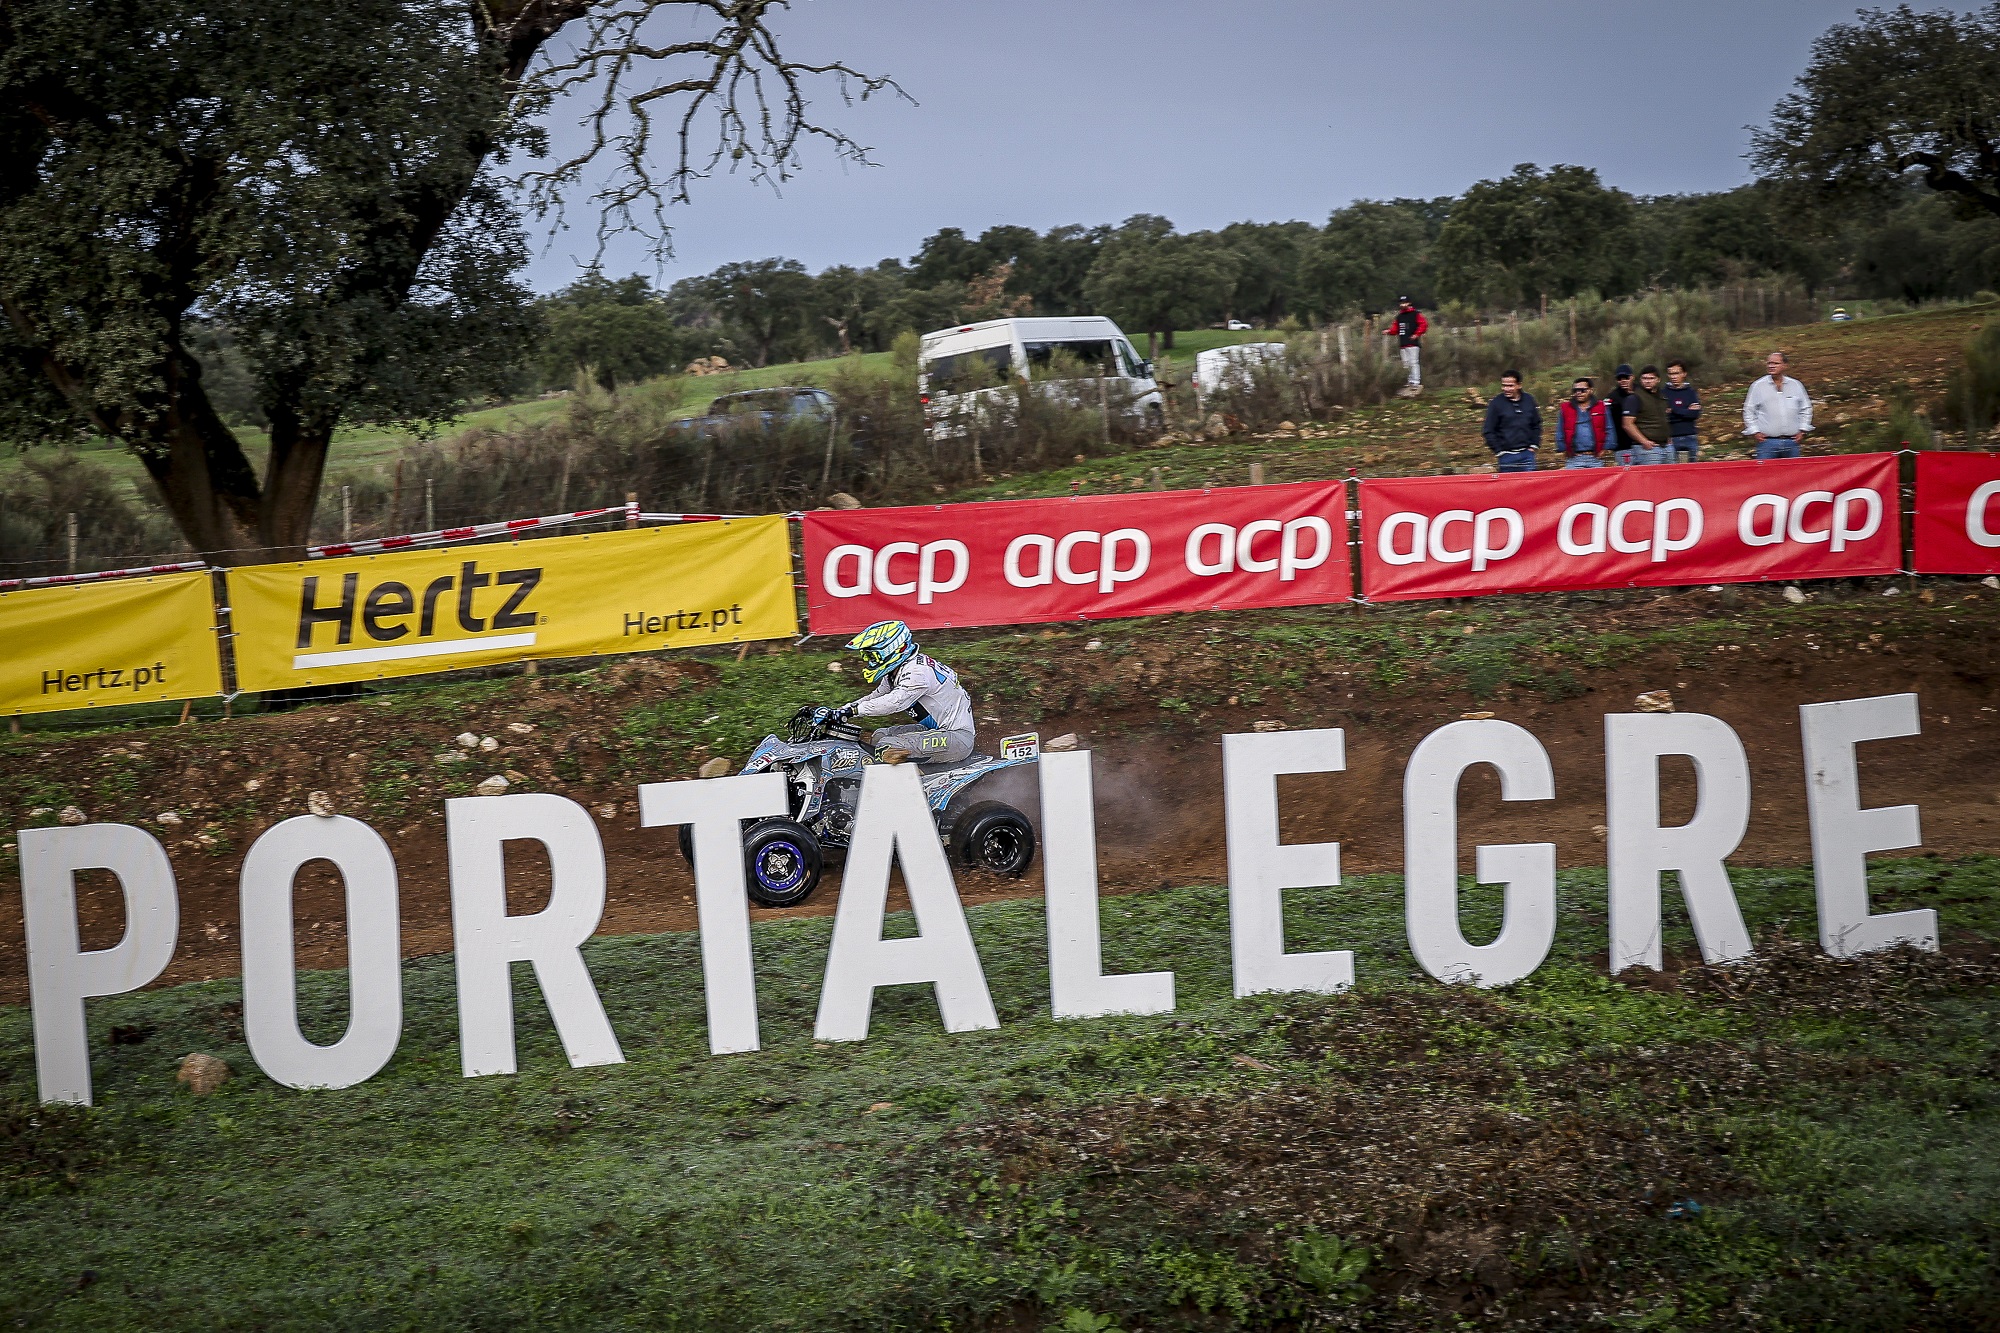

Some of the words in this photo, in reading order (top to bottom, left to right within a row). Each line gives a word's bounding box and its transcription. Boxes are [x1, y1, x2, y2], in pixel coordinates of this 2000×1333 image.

[1377, 507, 1525, 572] acp
[1556, 497, 1704, 563] acp
[1737, 487, 1883, 553] acp
[822, 538, 970, 605] acp
[1003, 528, 1152, 594] acp
[1184, 515, 1332, 581] acp
[296, 560, 544, 649] Hertz
[623, 603, 742, 637] Hertz.pt
[41, 661, 166, 695] Hertz.pt
[922, 736, 948, 750] FOX
[1011, 746, 1033, 758] 152
[17, 692, 1940, 1108] PORTALEGRE
